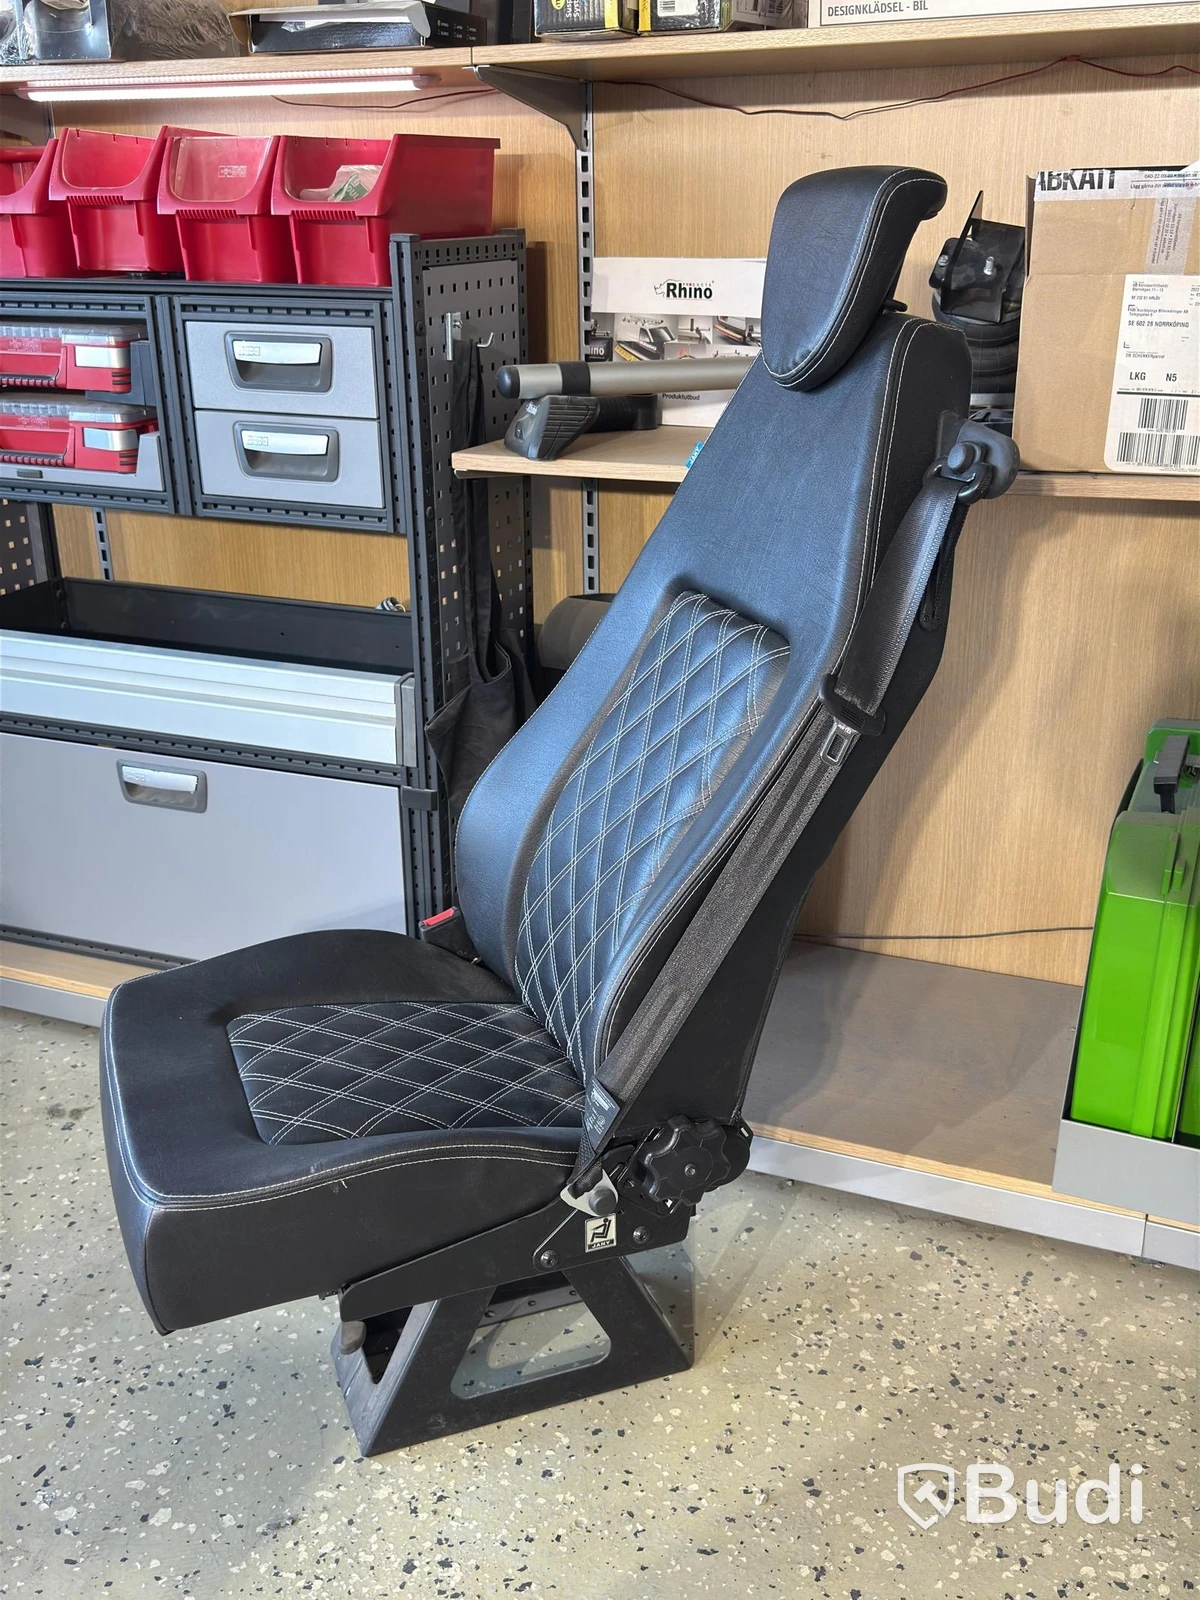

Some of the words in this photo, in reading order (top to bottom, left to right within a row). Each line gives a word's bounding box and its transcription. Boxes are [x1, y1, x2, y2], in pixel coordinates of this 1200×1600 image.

[828, 0, 904, 16] DESIGNKLÄDSEL
[913, 0, 928, 10] BIL
[666, 282, 712, 299] Rhino
[1130, 372, 1146, 380] LKG
[1166, 373, 1177, 382] N5
[592, 1240, 610, 1248] JANY
